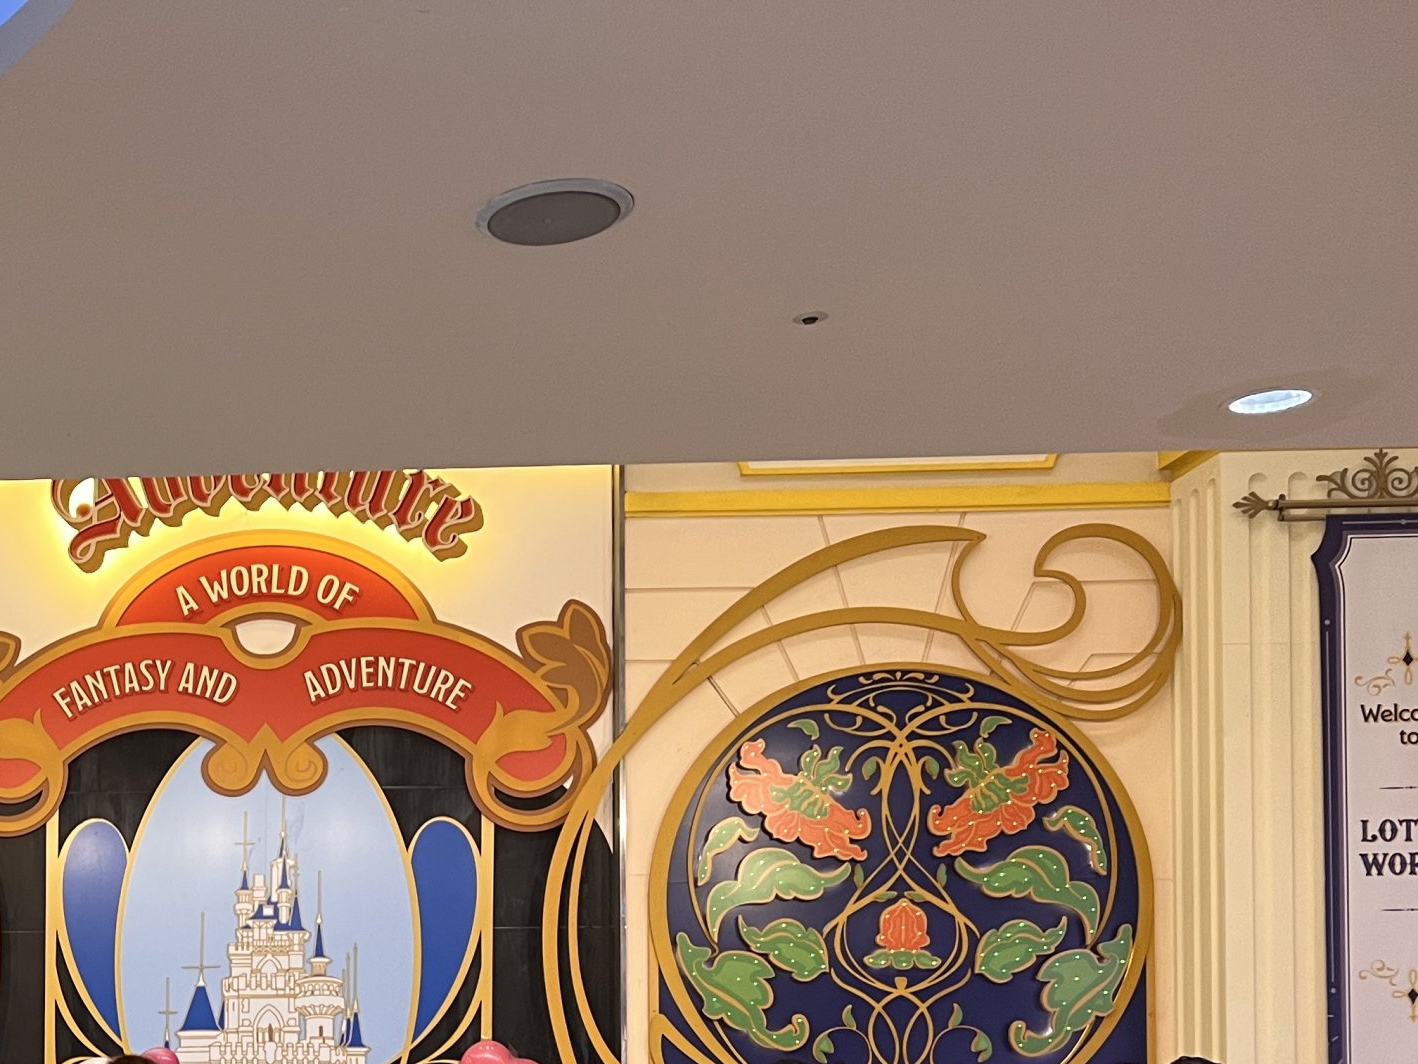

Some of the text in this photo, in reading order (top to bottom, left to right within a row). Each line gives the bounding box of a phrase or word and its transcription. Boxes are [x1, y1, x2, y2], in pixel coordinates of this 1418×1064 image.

[175, 563, 361, 617] A WORLD OF
[52, 656, 473, 719] FANTASY AND ADVENTURE
[1399, 730, 1418, 745] to
